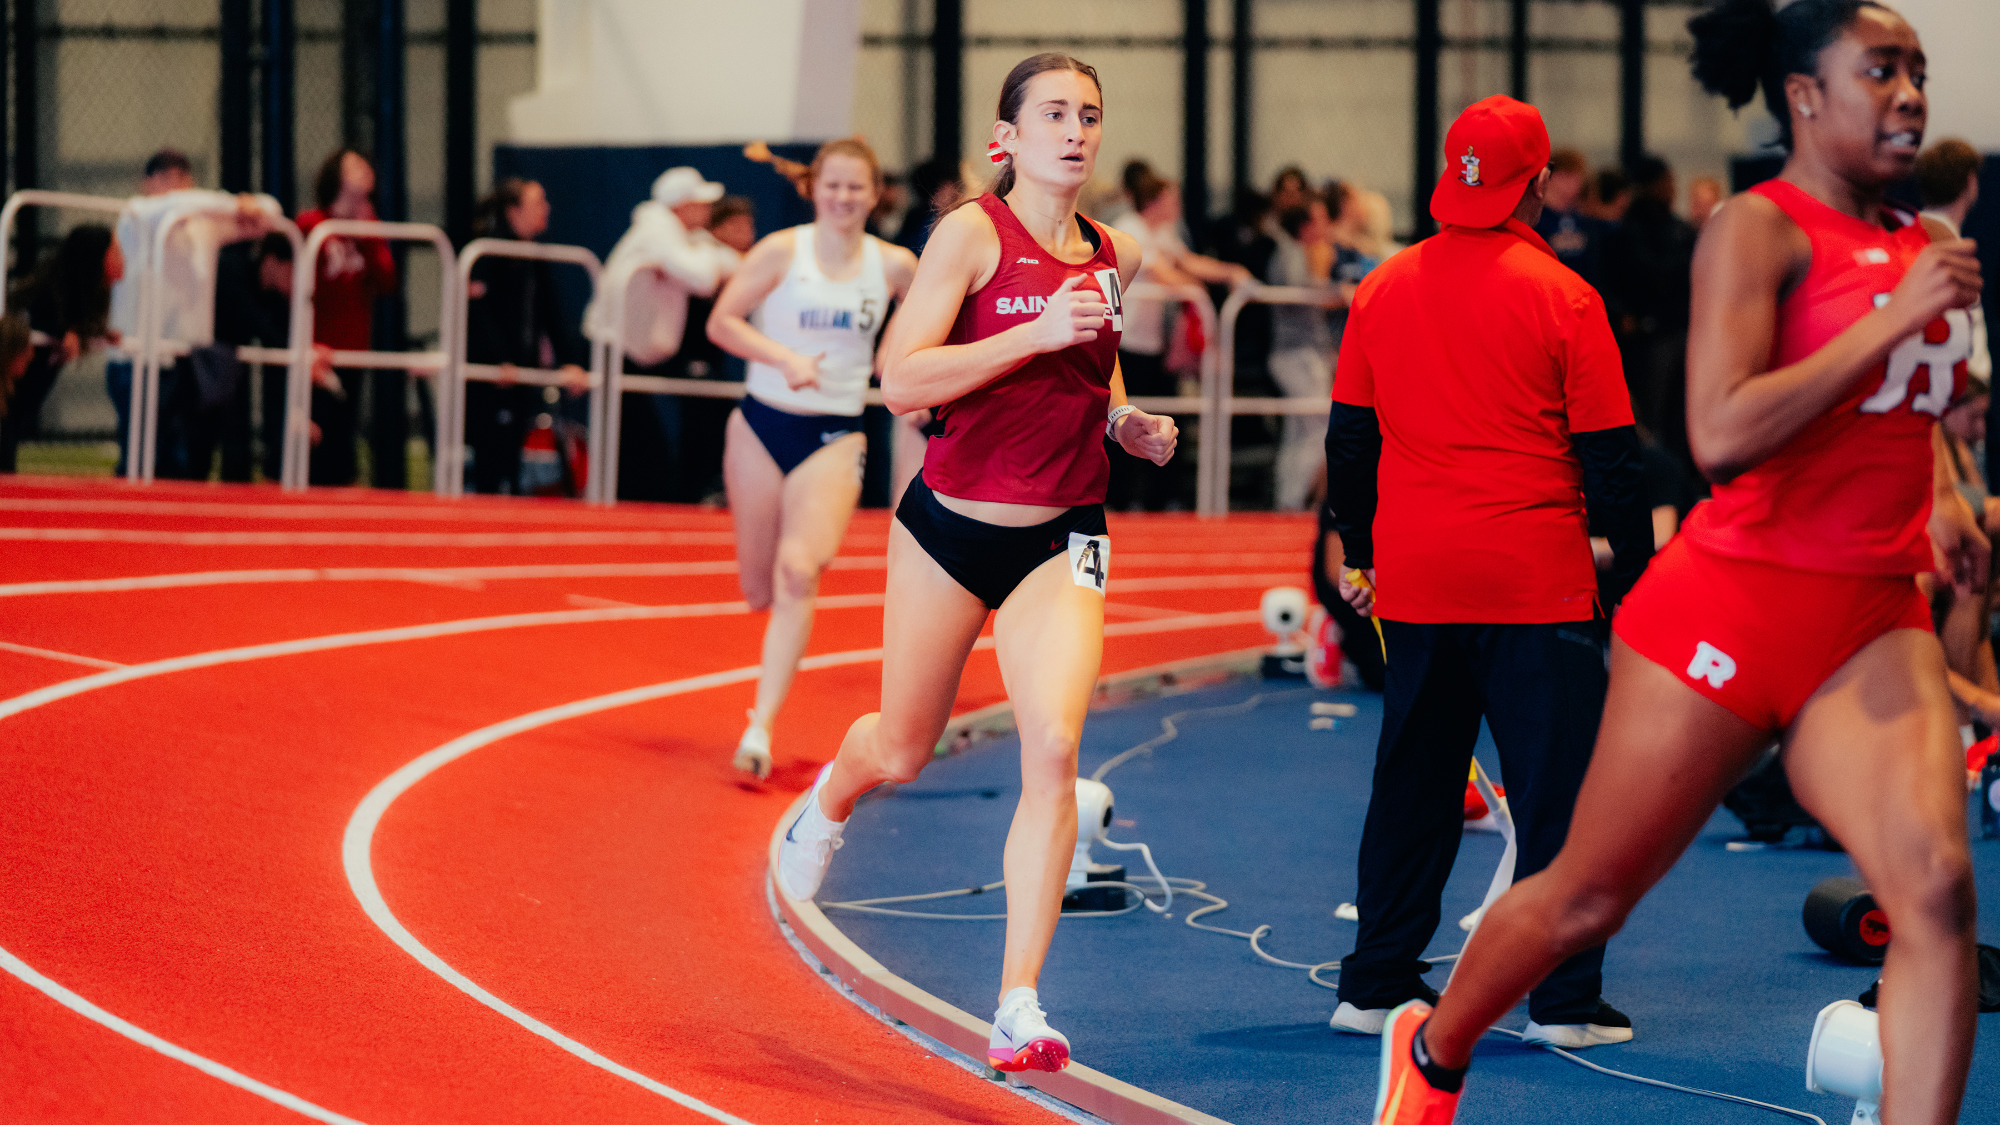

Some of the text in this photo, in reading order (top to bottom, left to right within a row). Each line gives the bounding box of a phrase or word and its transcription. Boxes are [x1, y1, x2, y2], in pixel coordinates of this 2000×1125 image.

[859, 299, 874, 331] 5
[996, 295, 1053, 315] SAIN
[1859, 292, 1973, 417] R
[1077, 539, 1105, 588] 4
[1686, 640, 1737, 690] R
